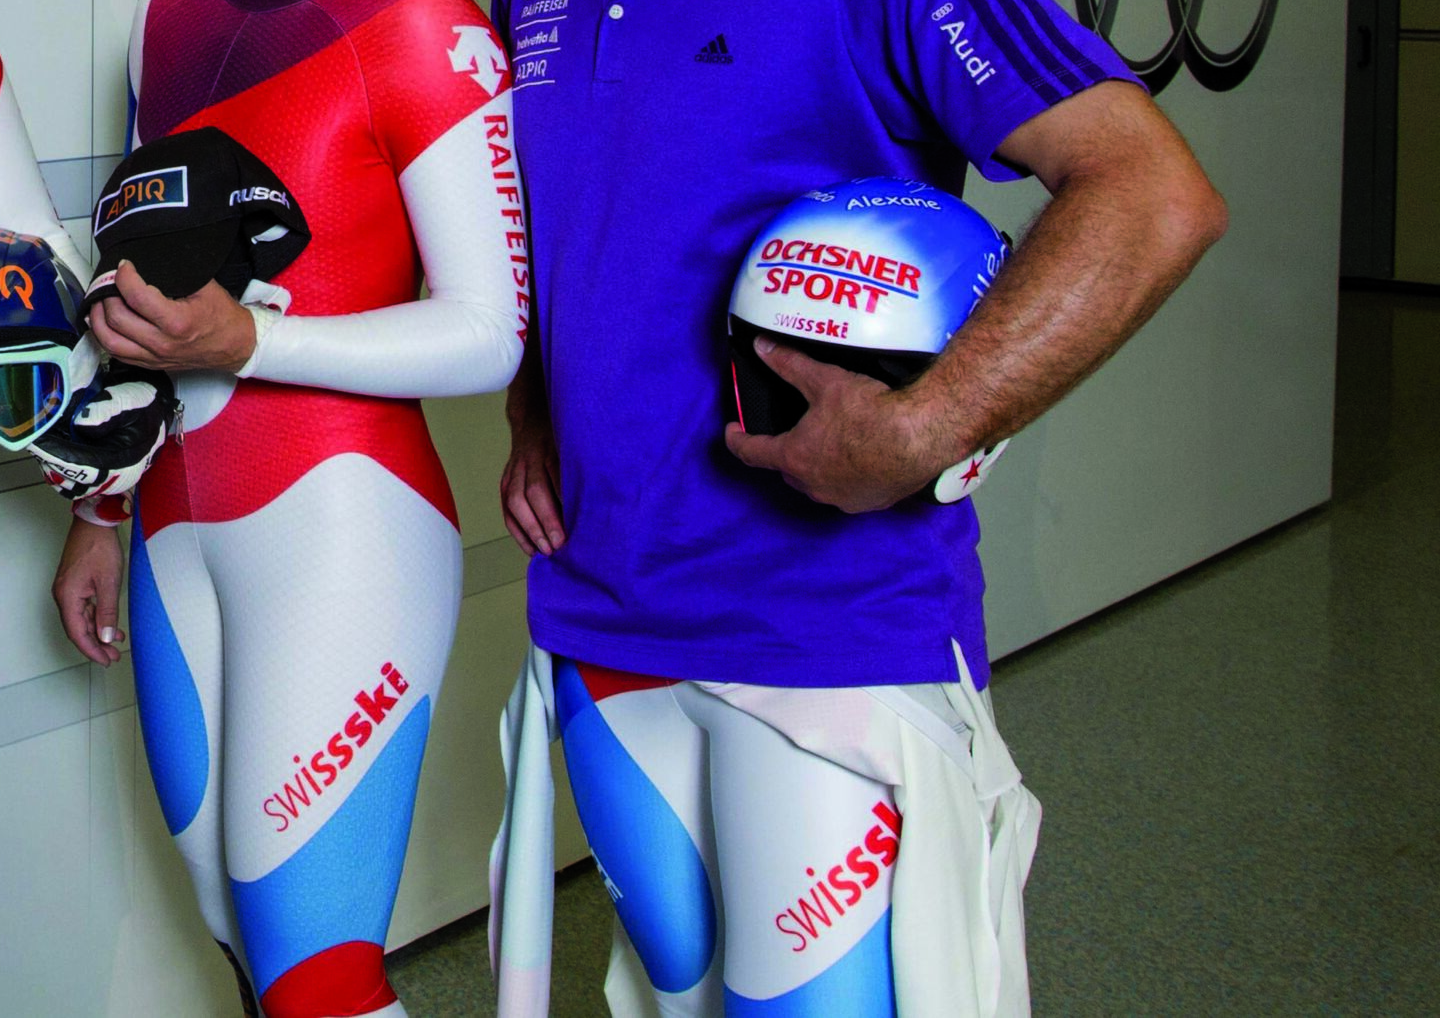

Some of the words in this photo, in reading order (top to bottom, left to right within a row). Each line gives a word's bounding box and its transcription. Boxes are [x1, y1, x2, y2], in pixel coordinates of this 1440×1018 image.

[517, 33, 548, 51] helvetia
[694, 54, 734, 64] adidas
[940, 21, 997, 86] Audi
[515, 59, 548, 82] ALPIQ
[846, 195, 942, 211] Alexane
[483, 114, 530, 347] RAIFFEISEN
[760, 238, 922, 292] OCHSNER
[763, 268, 889, 314] SPORT
[773, 312, 849, 339] swissski
[263, 662, 410, 832] swissski
